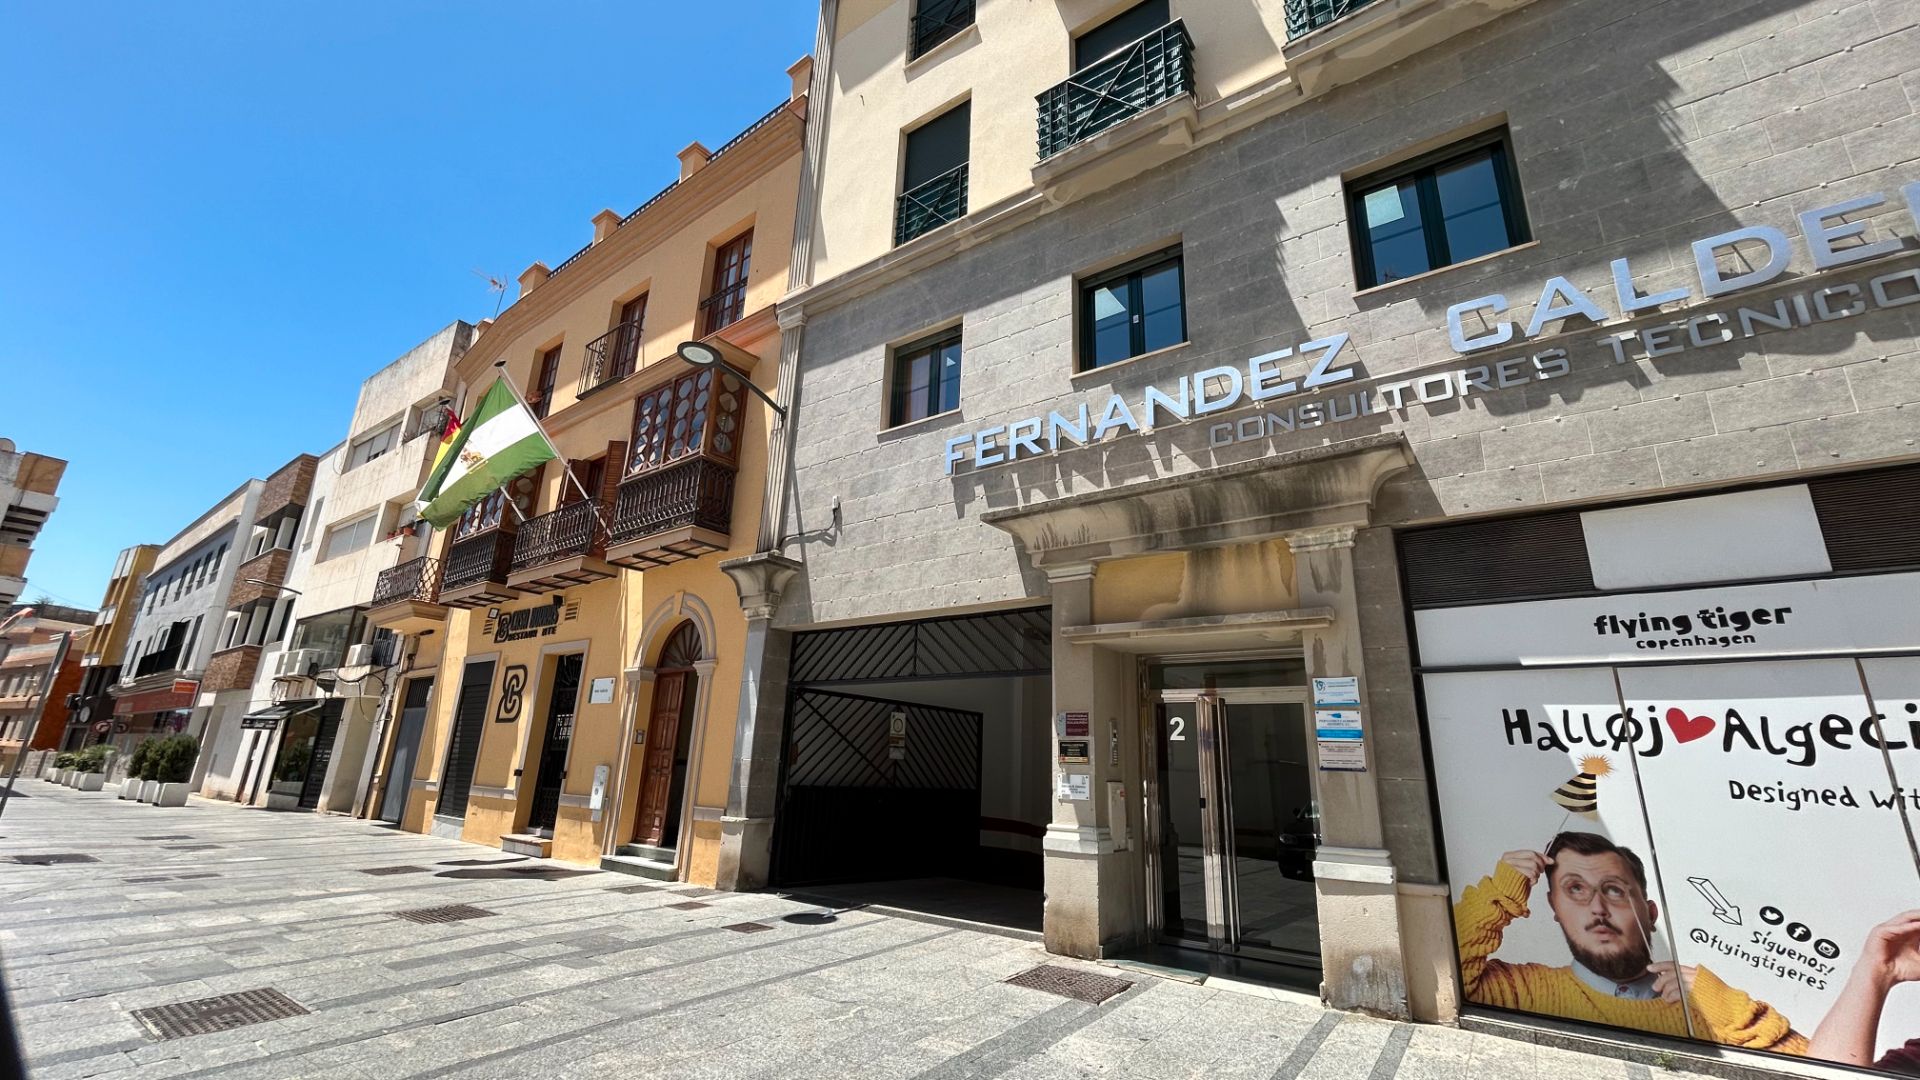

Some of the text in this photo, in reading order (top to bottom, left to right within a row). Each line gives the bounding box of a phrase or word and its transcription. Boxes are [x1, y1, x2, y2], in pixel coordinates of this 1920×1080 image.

[945, 180, 1920, 475] FERNANDEZ CALDE
[1209, 348, 1570, 447] CONSULTORES
[1594, 606, 1792, 638] flying tiger
[1636, 634, 1756, 650] copenhagen
[1170, 716, 1186, 741] 2
[1502, 705, 1664, 757] Halløj
[1729, 780, 1860, 811] Designed
[1690, 928, 1828, 990] @flyingtigeres
[1750, 931, 1836, 976] Síguenos!
